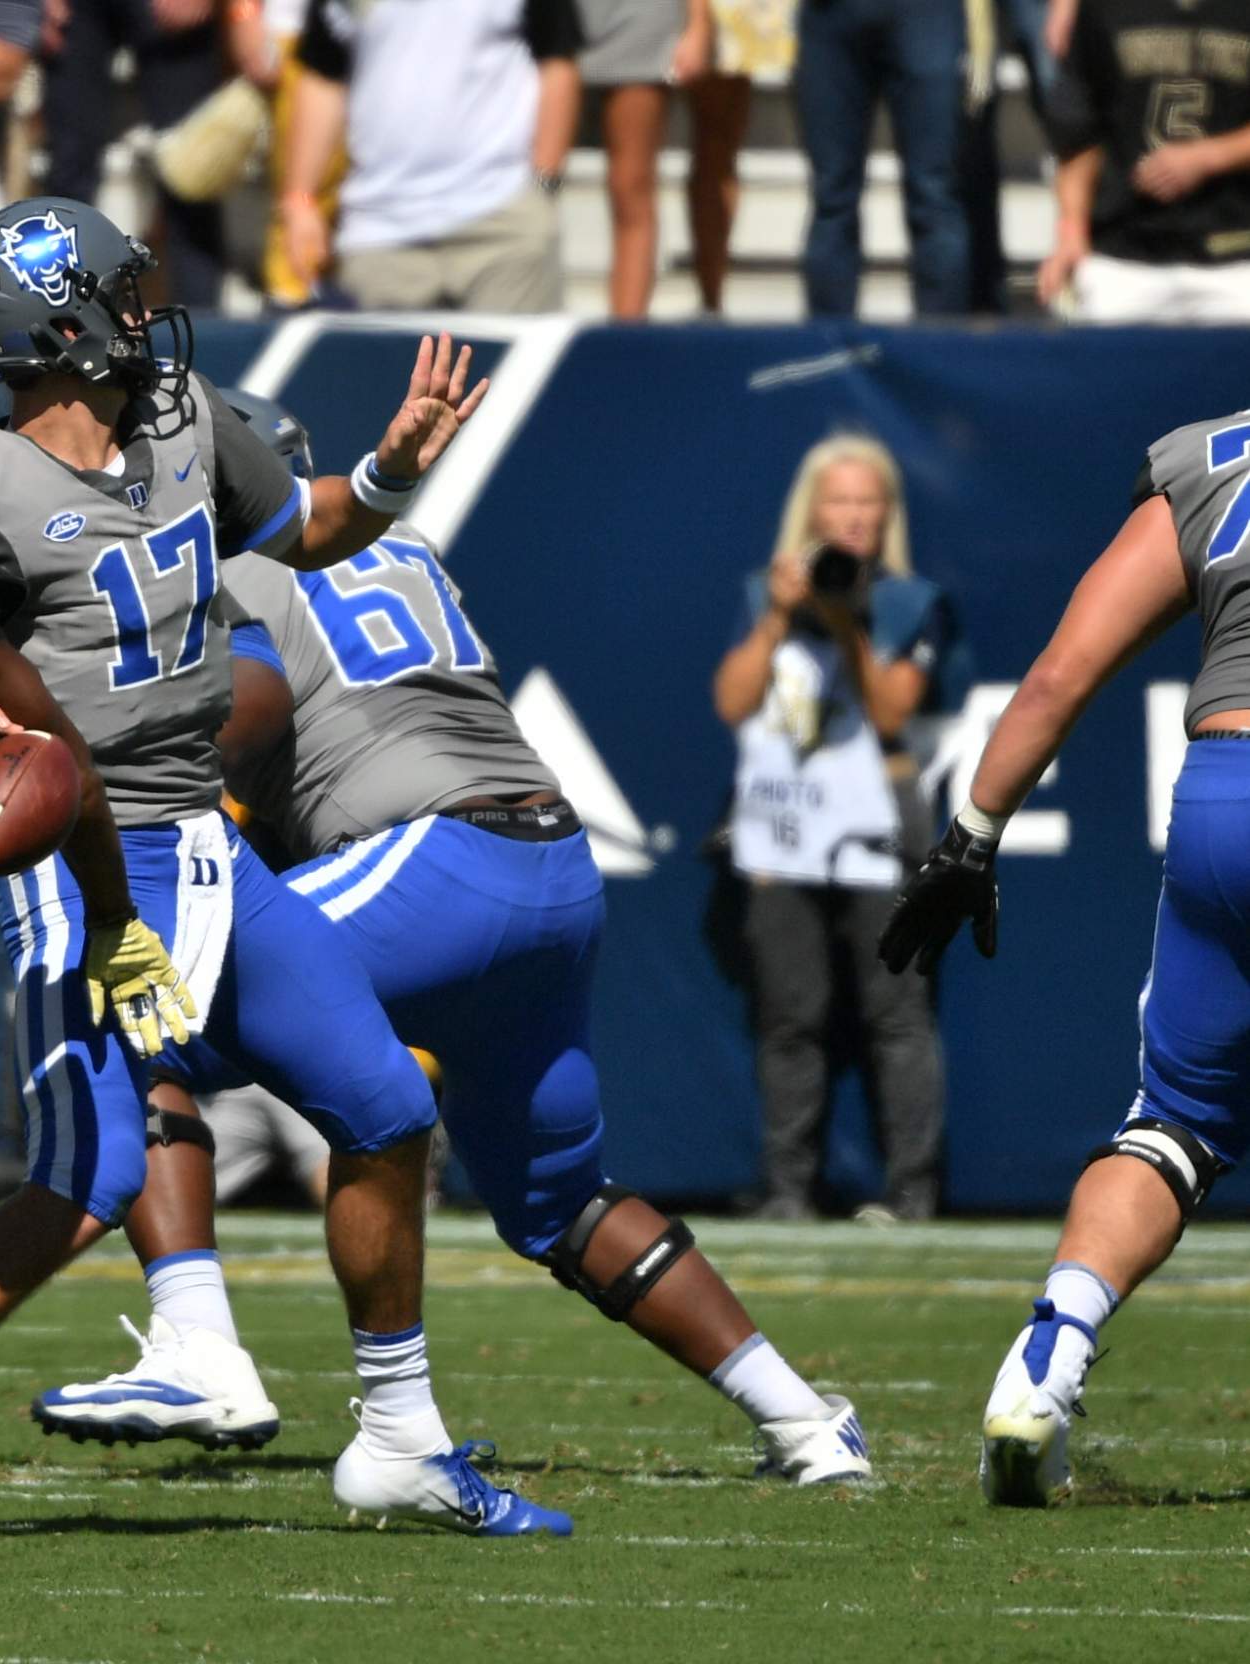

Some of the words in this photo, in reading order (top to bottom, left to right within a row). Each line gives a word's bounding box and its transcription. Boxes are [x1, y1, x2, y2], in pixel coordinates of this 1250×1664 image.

[52, 513, 80, 537] ACC
[88, 500, 219, 693] 17
[289, 536, 485, 688] 67
[471, 811, 509, 823] PRO
[517, 810, 542, 822] NIK
